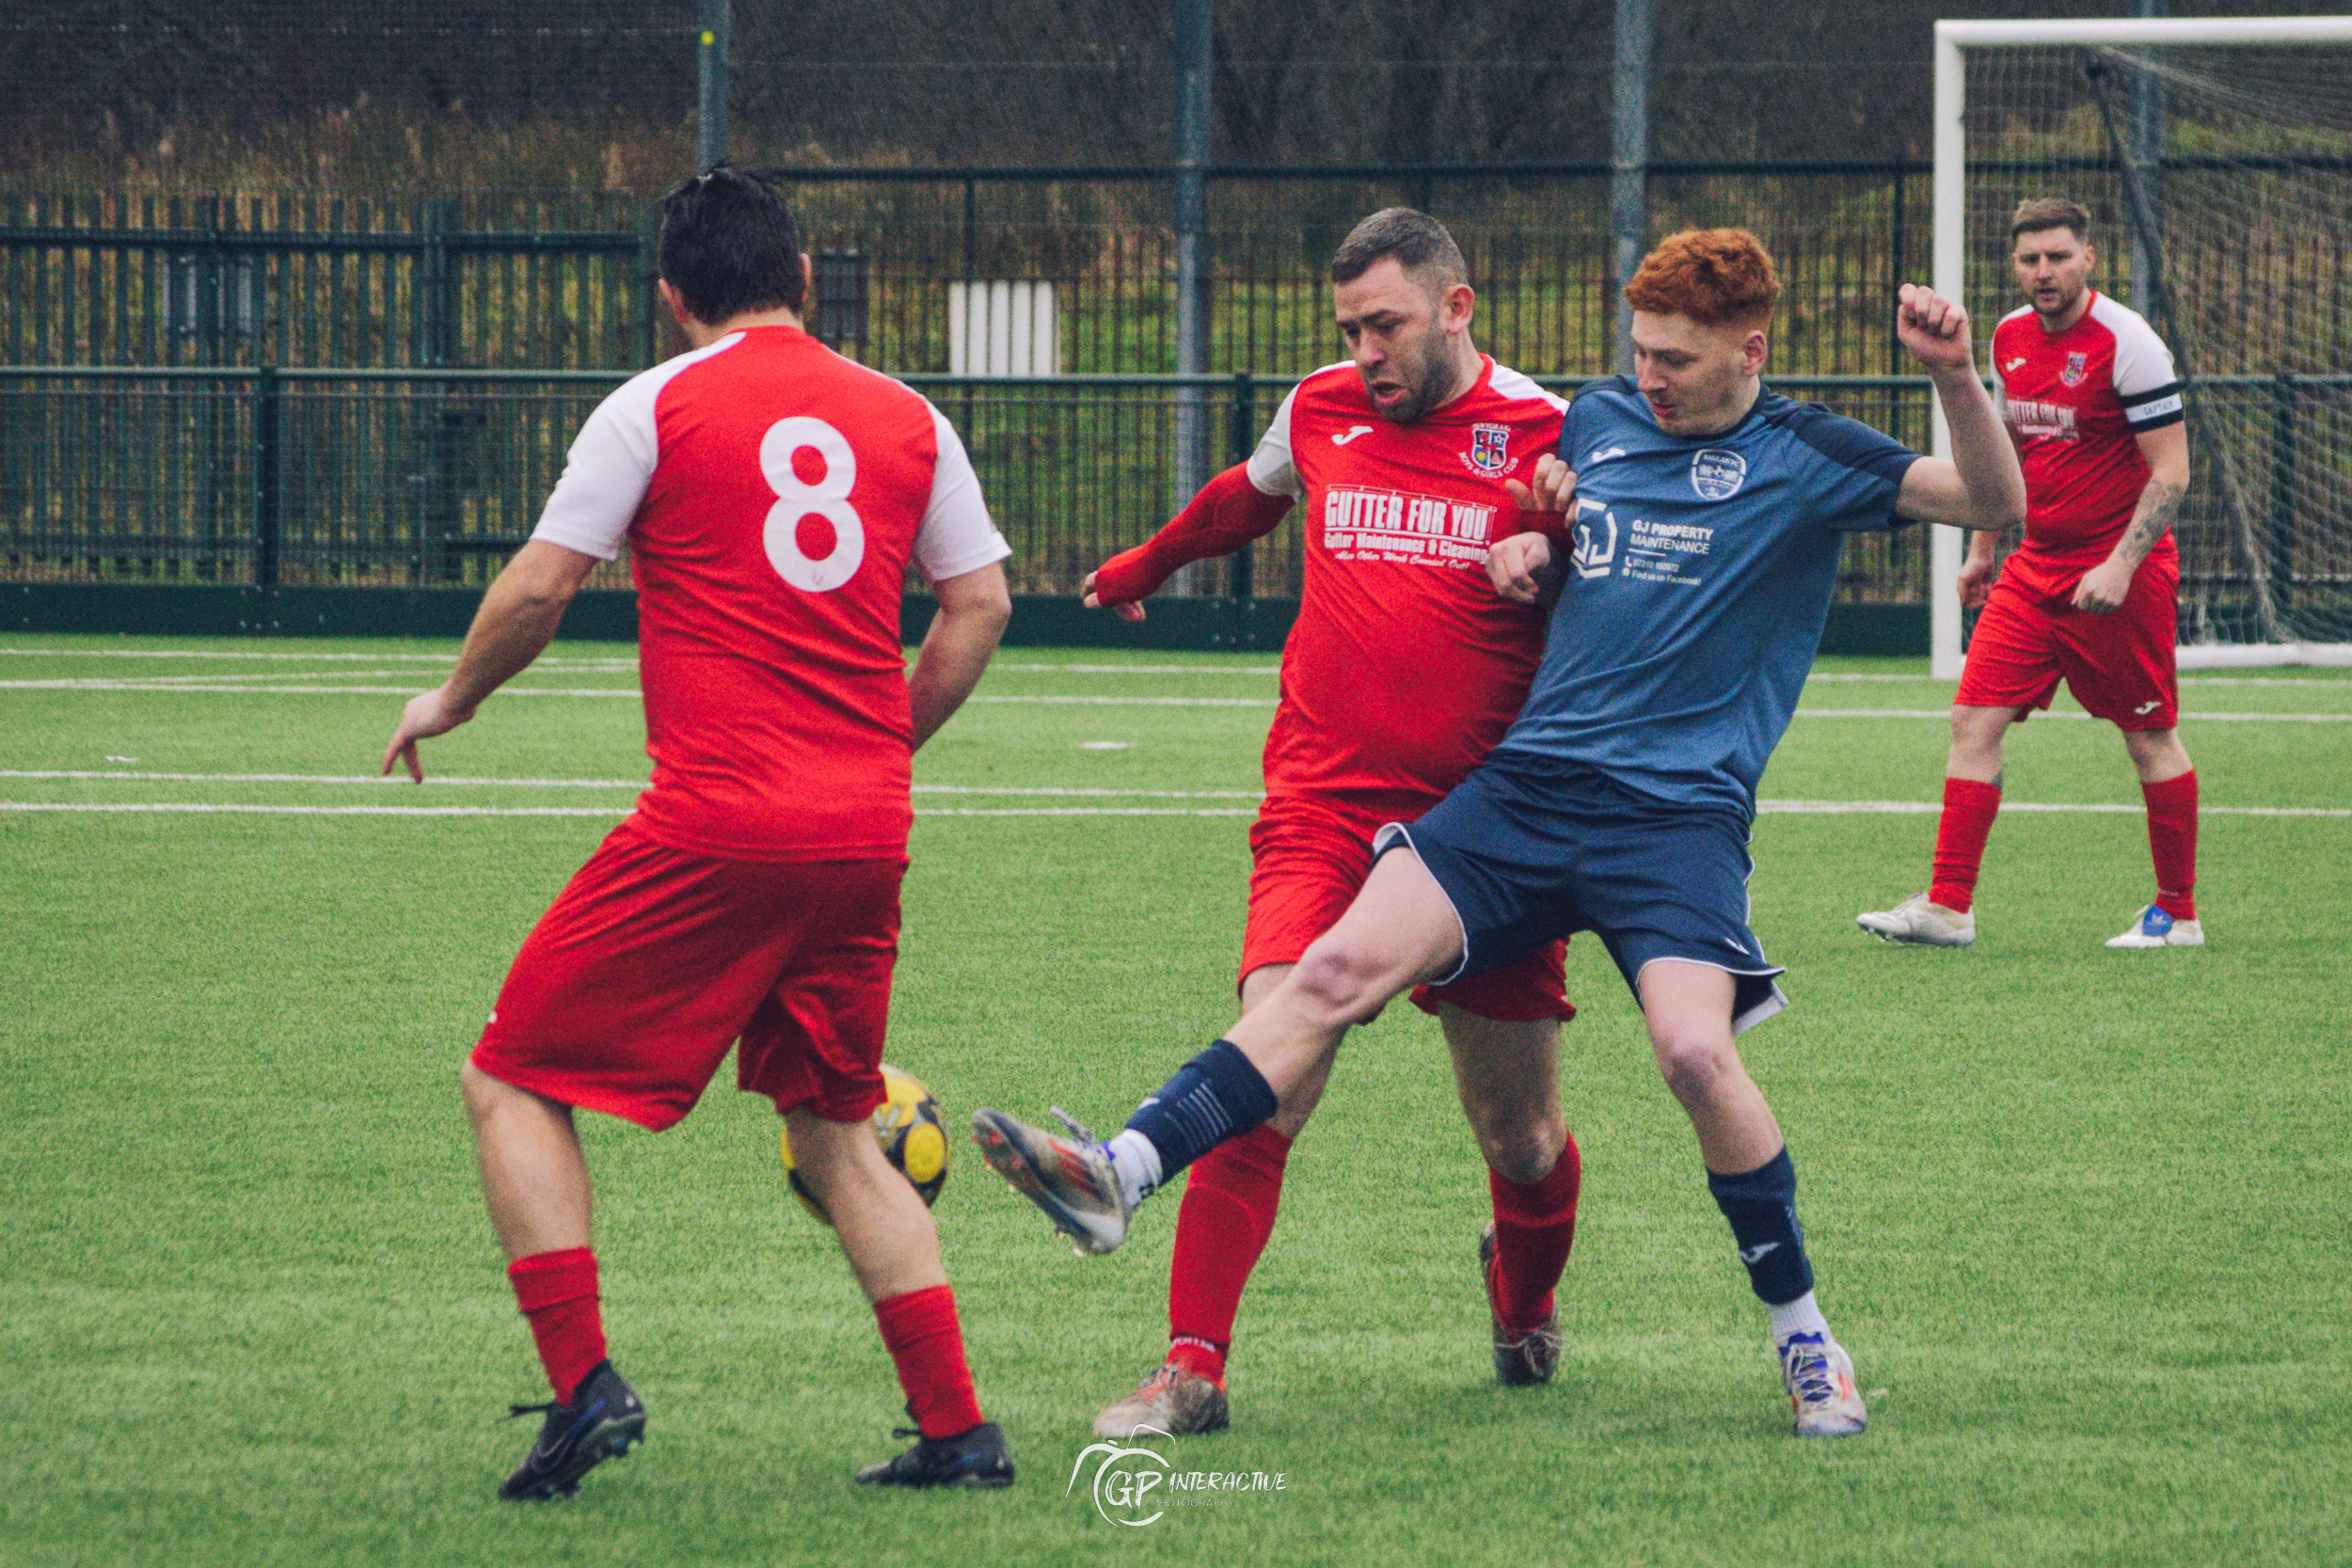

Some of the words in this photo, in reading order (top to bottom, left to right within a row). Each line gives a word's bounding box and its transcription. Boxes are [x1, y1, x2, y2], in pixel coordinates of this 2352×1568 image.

[759, 416, 865, 593] 8
[1325, 491, 1404, 530] GUTTER
[1406, 499, 1447, 534] FOR
[1451, 504, 1489, 540] YOU
[1632, 519, 1650, 533] GJ
[1651, 522, 1714, 541] PROPERTY
[1324, 532, 1355, 548] Gutter
[1356, 532, 1425, 553] Maintenance
[1428, 539, 1438, 555] &
[1630, 533, 1710, 554] MAINTENANCE
[1631, 569, 1647, 579] Find
